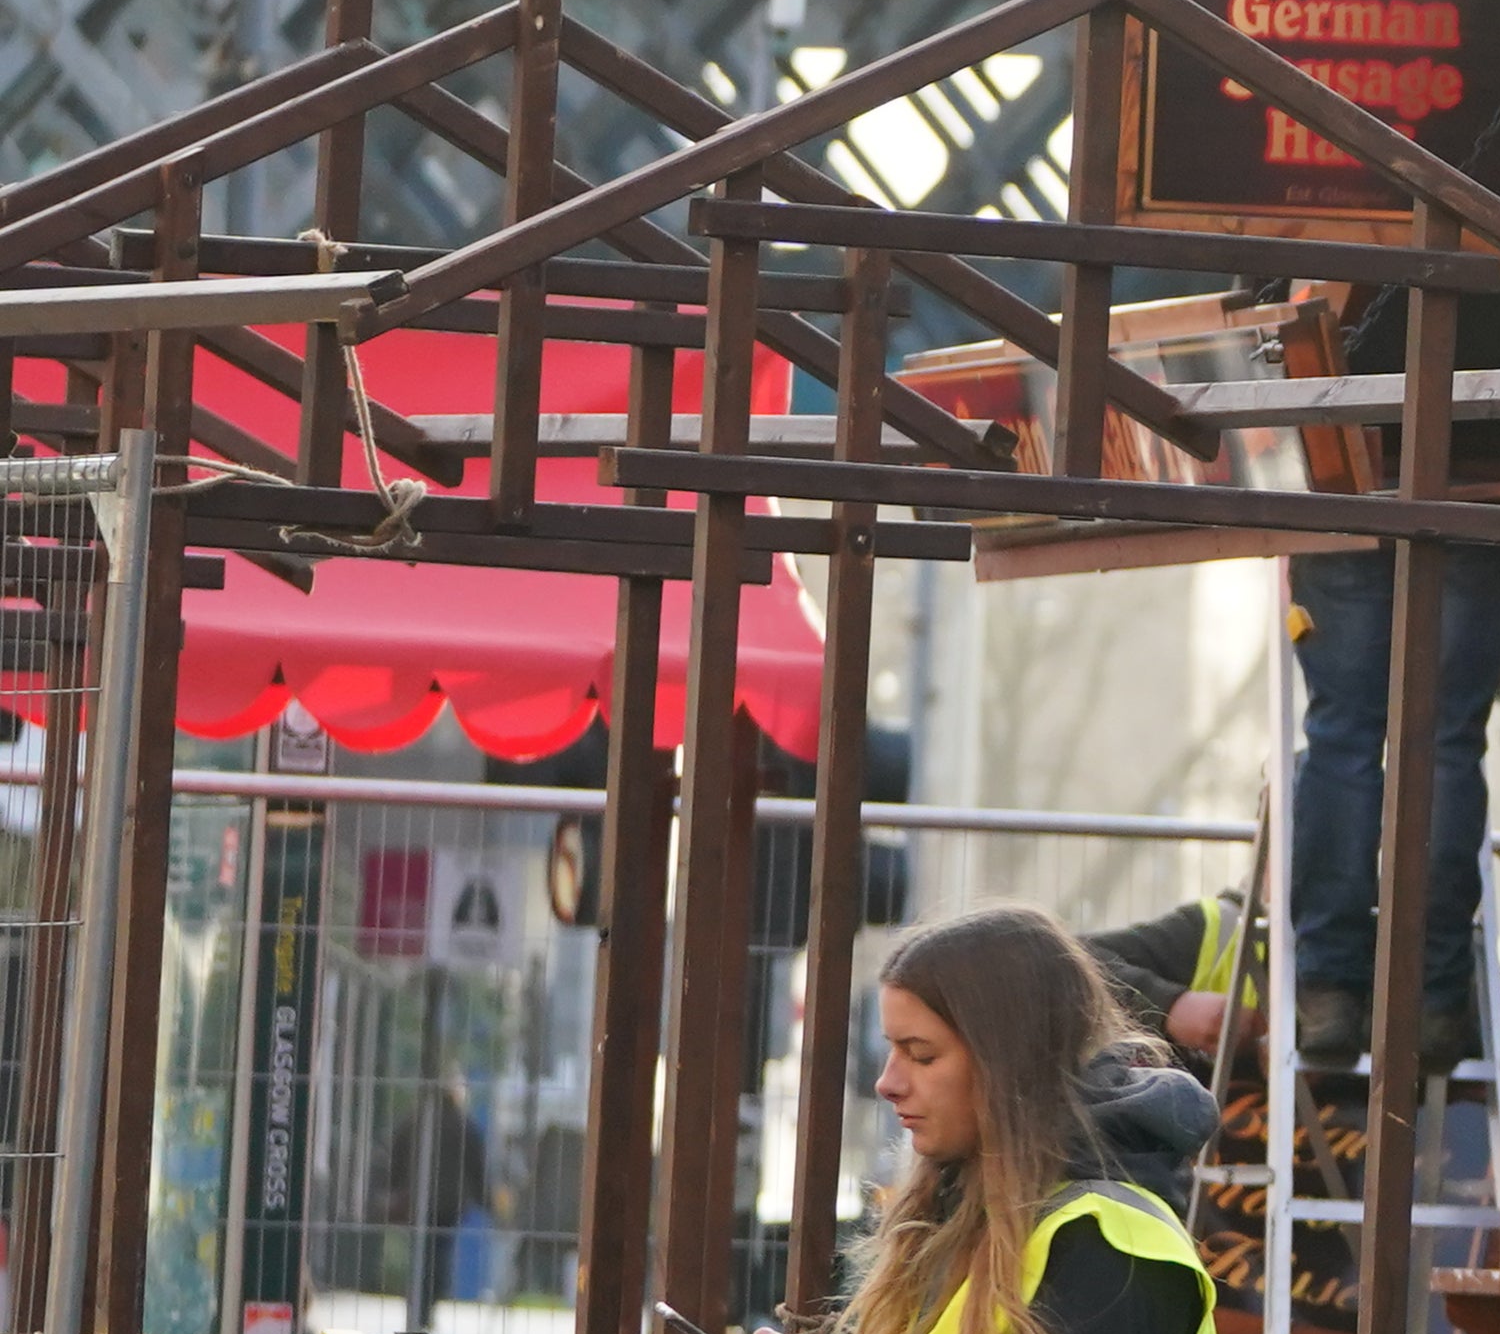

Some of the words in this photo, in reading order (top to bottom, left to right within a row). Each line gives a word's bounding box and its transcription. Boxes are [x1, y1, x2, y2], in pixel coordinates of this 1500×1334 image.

[1220, 58, 1463, 120] sage
[270, 1005, 297, 1124] GLASGOW
[265, 1127, 290, 1211] CROSS
